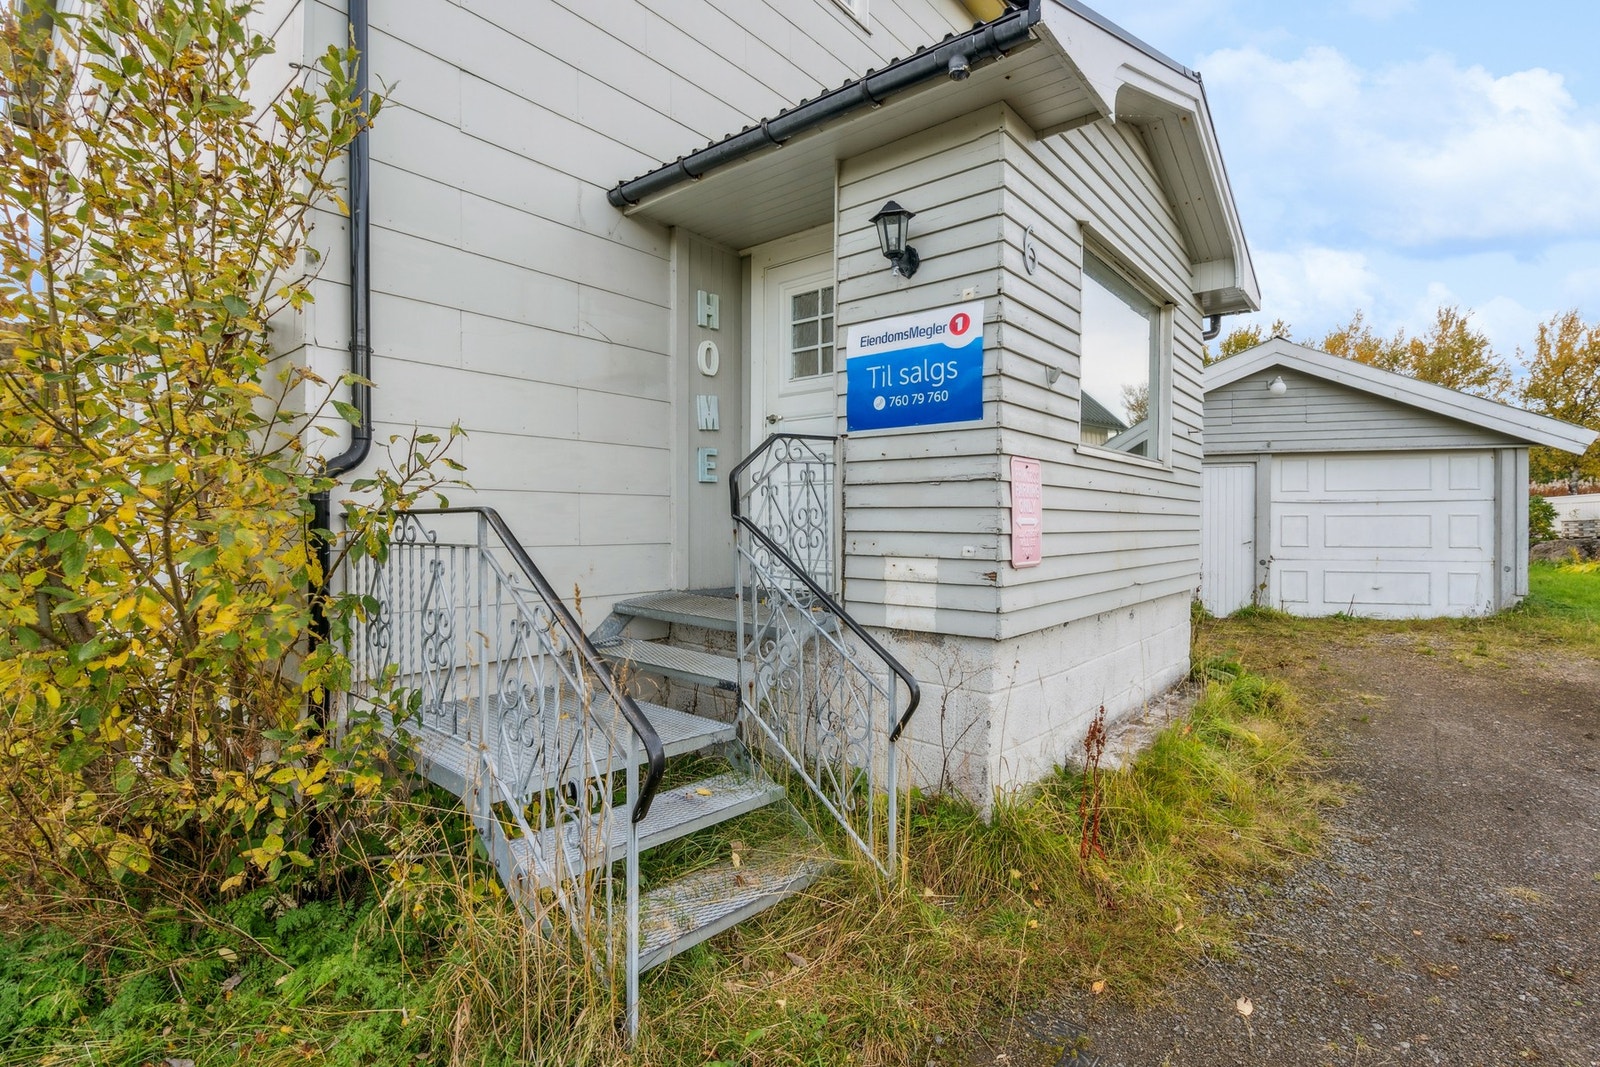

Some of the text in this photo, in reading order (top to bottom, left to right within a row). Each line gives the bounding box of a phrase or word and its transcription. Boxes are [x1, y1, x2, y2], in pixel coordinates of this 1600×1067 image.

[1023, 224, 1038, 276] 6
[860, 322, 947, 348] EiendomsMegler
[697, 290, 720, 483] HOME
[866, 358, 958, 389] Til salgs
[889, 390, 949, 407] 760 79 760
